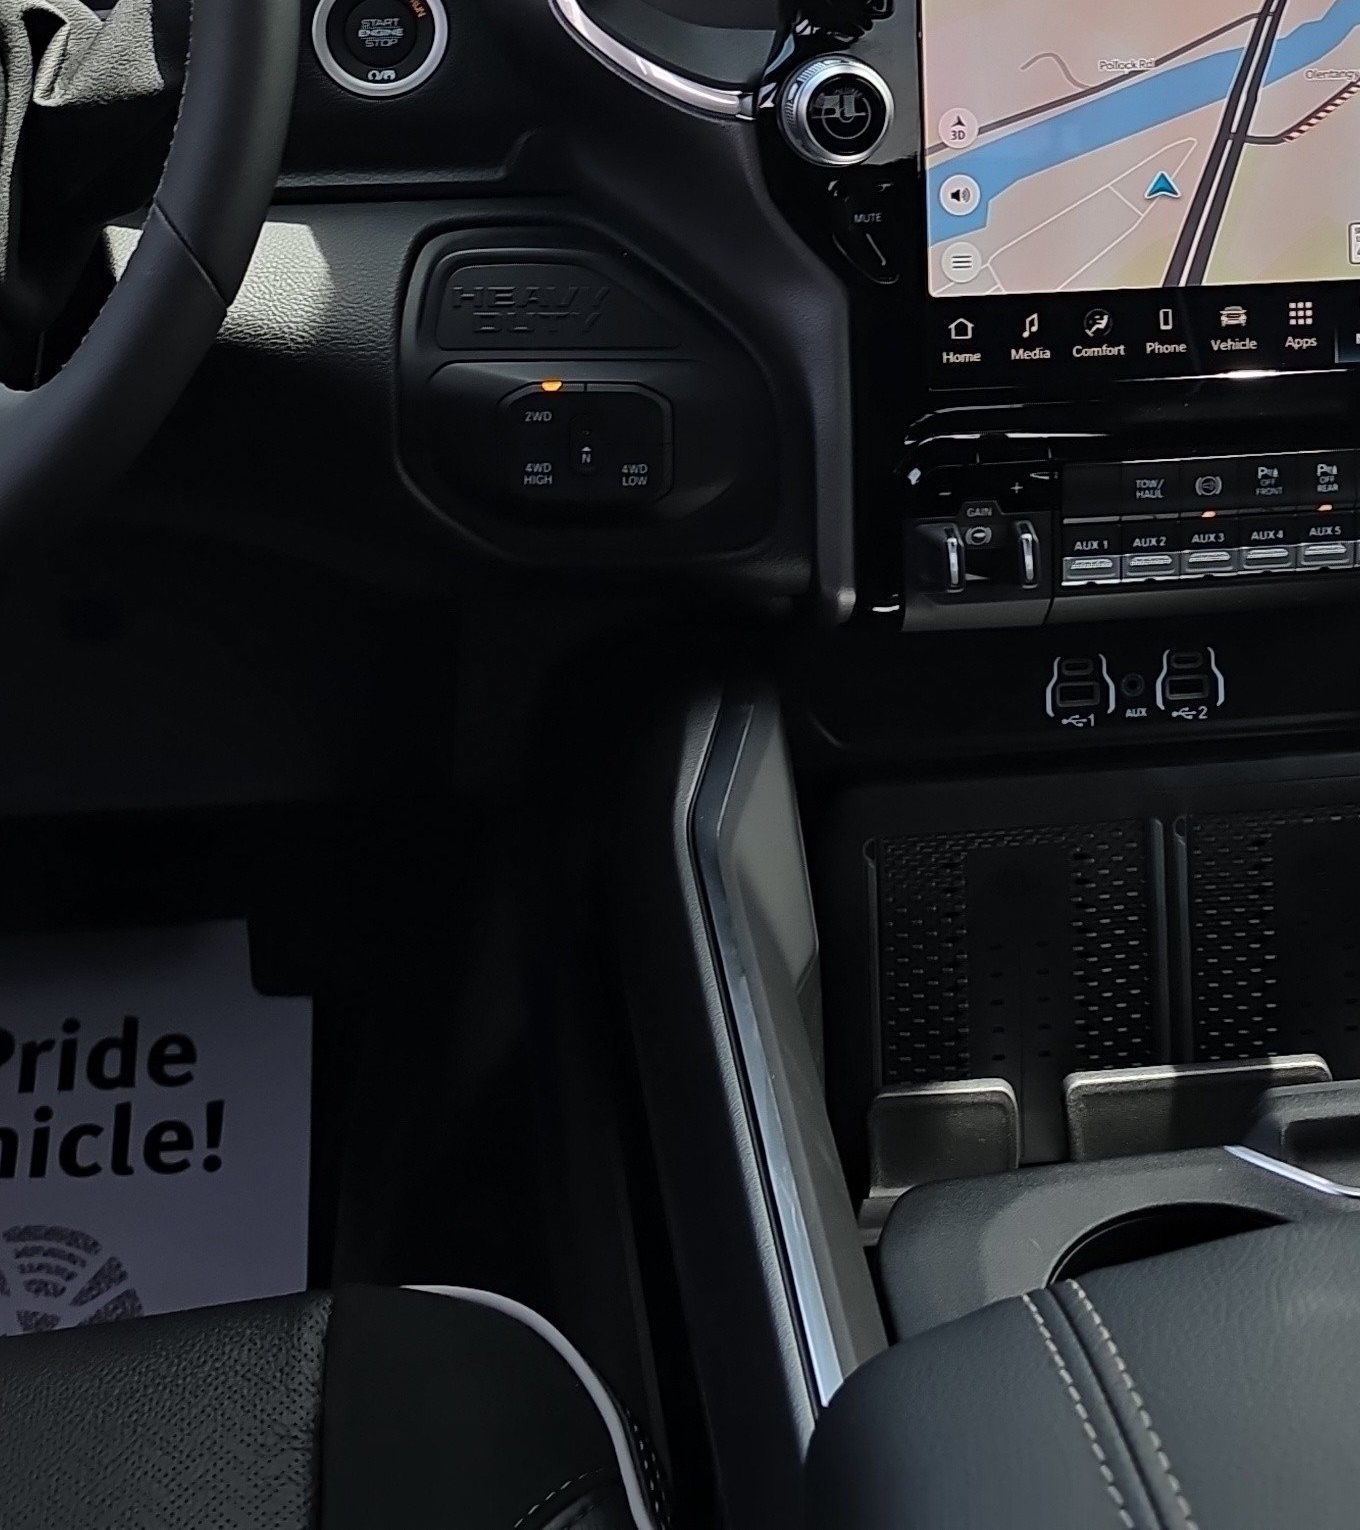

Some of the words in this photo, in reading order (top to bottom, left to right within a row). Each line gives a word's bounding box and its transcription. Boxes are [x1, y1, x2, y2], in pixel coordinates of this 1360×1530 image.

[361, 18, 400, 27] START
[365, 39, 398, 47] STOP
[1099, 59, 1138, 70] Pollock
[1139, 59, 1155, 68] Rd
[949, 129, 966, 141] 3D
[854, 213, 882, 223] MUTE
[452, 286, 612, 308] HEAVY
[473, 312, 602, 333] DUTY
[1146, 340, 1187, 353] Phone
[1211, 337, 1257, 351] Vehicle
[1285, 335, 1317, 349] Apps
[942, 350, 981, 362] Home
[1011, 347, 1051, 359] Media
[1072, 344, 1125, 358] Comfort
[525, 411, 552, 422] 2WD
[582, 452, 591, 465] N
[525, 463, 552, 474] 4WD
[622, 464, 648, 475] 4WD
[524, 474, 553, 486] HIGH
[622, 475, 648, 487] LOW
[1135, 479, 1164, 489] TOW/
[1256, 486, 1283, 496] FRONT
[1317, 483, 1339, 492] REAR
[1135, 488, 1164, 499] HAUL
[967, 507, 992, 517] GAIN
[1251, 530, 1274, 540] AUX
[1275, 529, 1284, 539] 4
[1309, 526, 1331, 536] AUX
[1334, 525, 1341, 535] 5
[1133, 537, 1157, 547] AUX
[1159, 536, 1166, 546] 2
[1191, 533, 1215, 543] AUX
[1217, 532, 1225, 542] 3
[1074, 540, 1099, 550] AUX
[1102, 539, 1109, 549] 1
[1125, 706, 1147, 717] AUX
[1198, 706, 1208, 719] 2
[1087, 713, 1095, 726] 1
